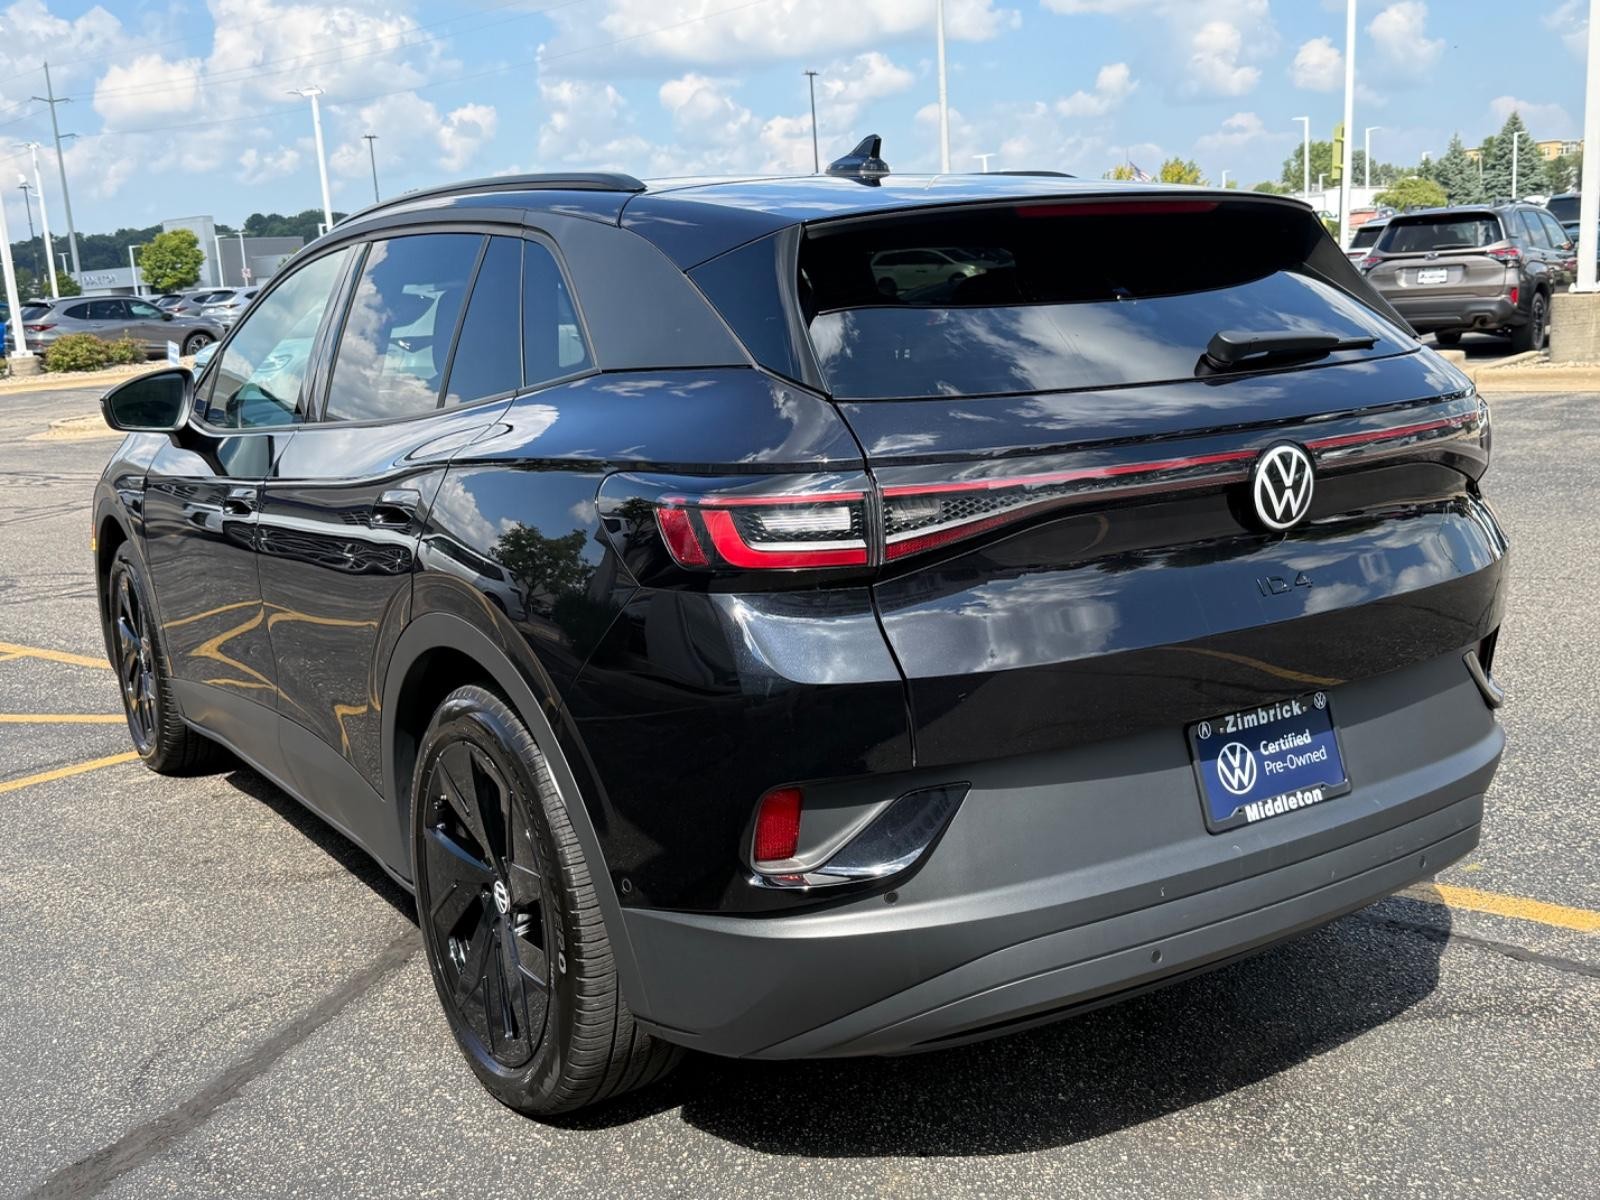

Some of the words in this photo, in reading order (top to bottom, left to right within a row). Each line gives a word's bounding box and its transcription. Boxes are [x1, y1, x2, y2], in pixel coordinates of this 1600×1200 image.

[1225, 700, 1302, 733] Zimbrick
[1260, 729, 1312, 755] Certified
[1264, 746, 1327, 775] Pre-Owned
[1245, 789, 1323, 822] Middleton
